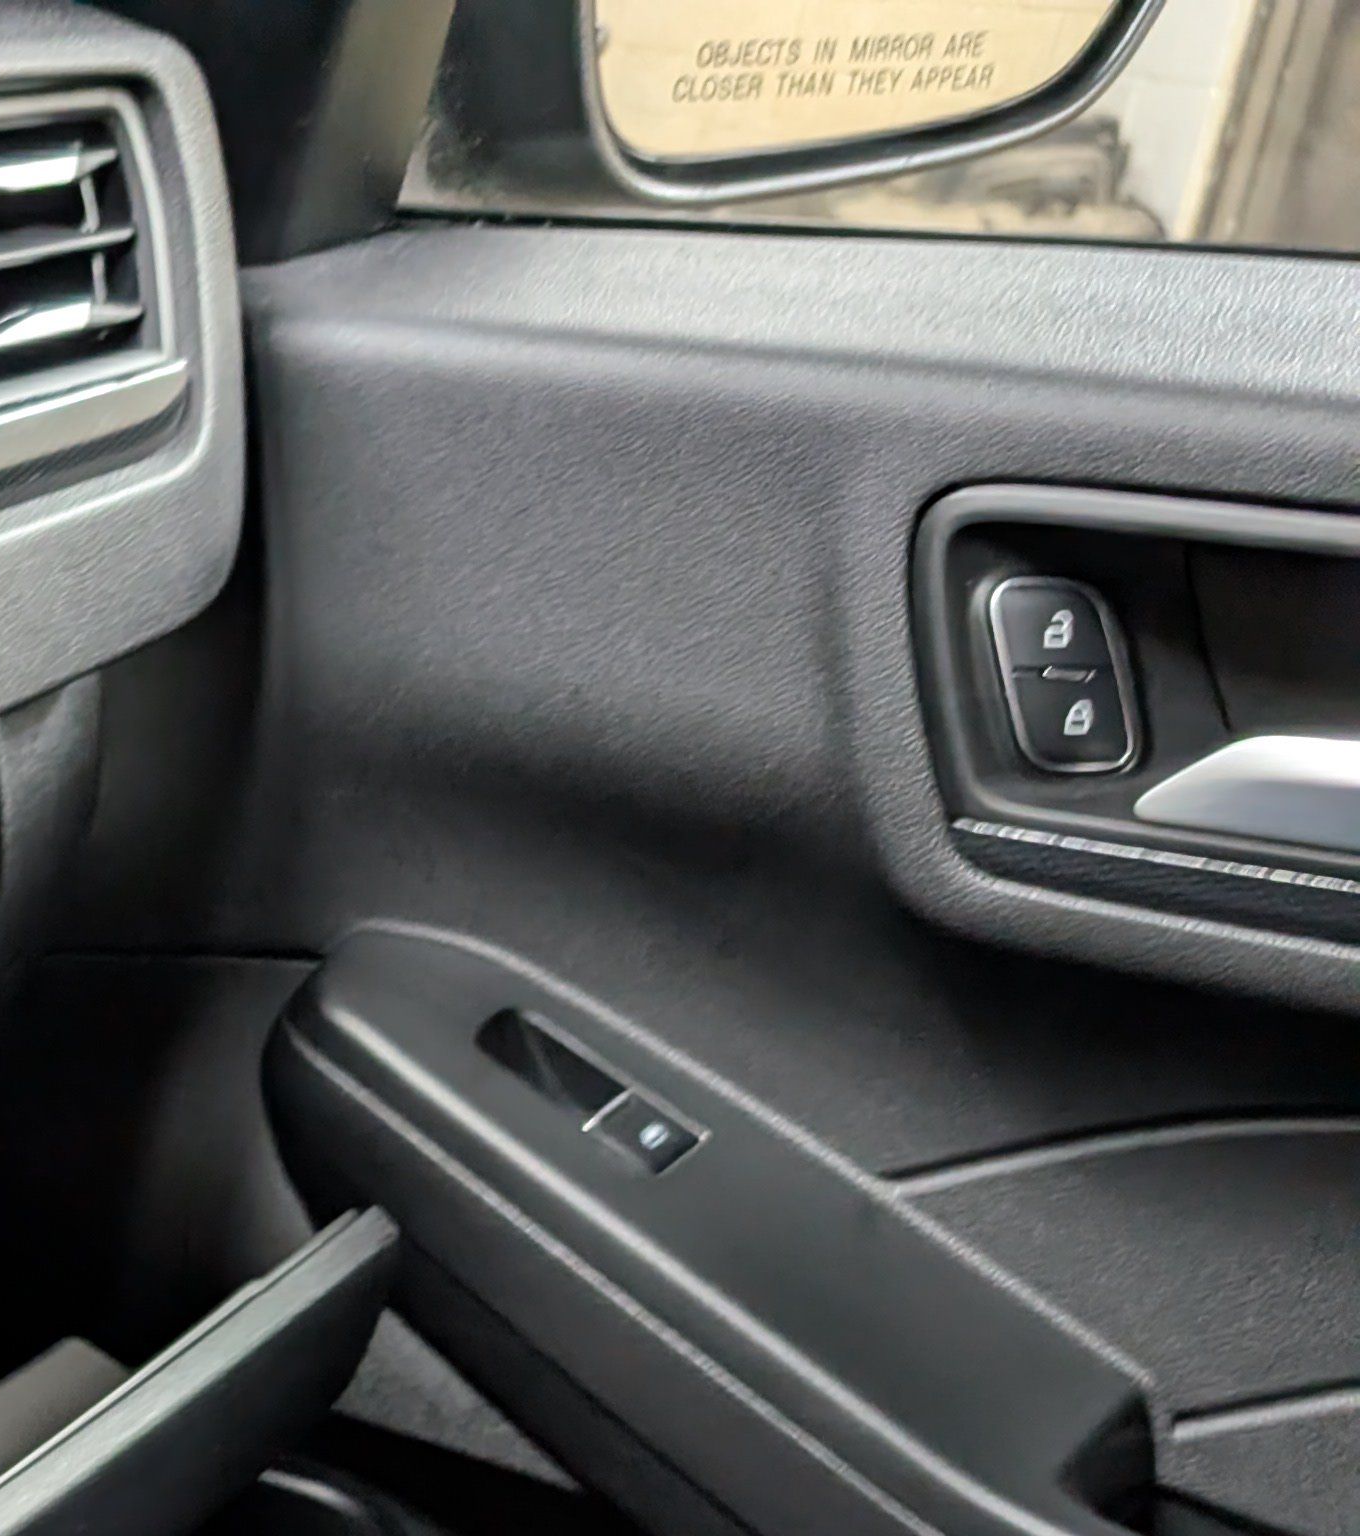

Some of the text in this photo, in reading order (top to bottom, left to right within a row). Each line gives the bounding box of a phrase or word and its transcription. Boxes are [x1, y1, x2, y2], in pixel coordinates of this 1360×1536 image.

[696, 31, 986, 67] OBJECTS IN MIRROR ARE
[672, 64, 995, 103] CLOSER THAN THEY APPEAR
